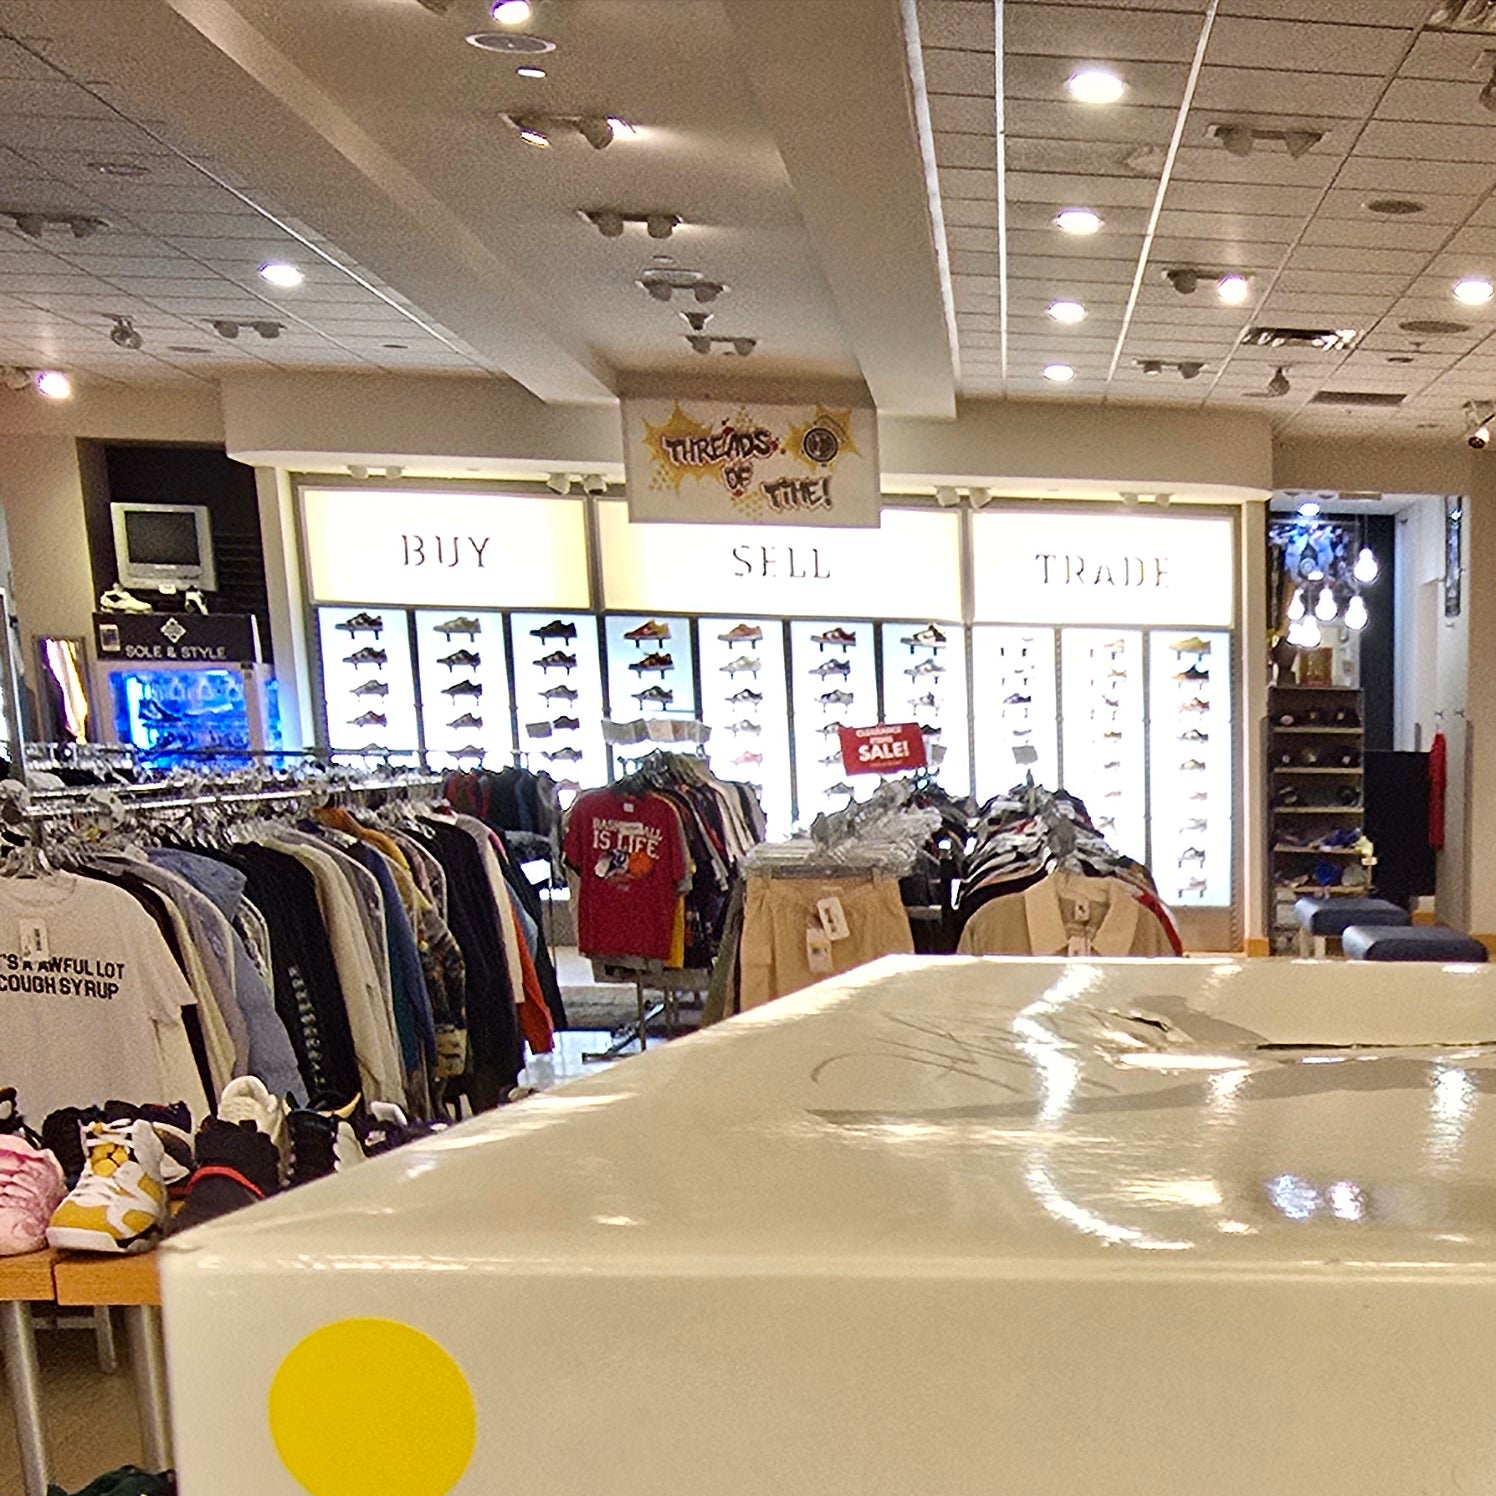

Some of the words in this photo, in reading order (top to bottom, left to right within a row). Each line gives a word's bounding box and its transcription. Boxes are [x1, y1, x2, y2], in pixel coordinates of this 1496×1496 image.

[663, 428, 772, 465] THREADS
[724, 465, 752, 490] OF
[402, 535, 489, 567] BUY
[733, 546, 830, 578] SELL
[1035, 553, 1168, 587] TRADE
[125, 645, 161, 658] SOLE
[167, 647, 176, 658] &
[181, 647, 226, 659] STYLE
[859, 741, 909, 762] SALE!
[593, 830, 611, 850] IS
[37, 956, 93, 976] AWFUL
[96, 960, 125, 980] LOT
[59, 977, 119, 1000] SYRUP
